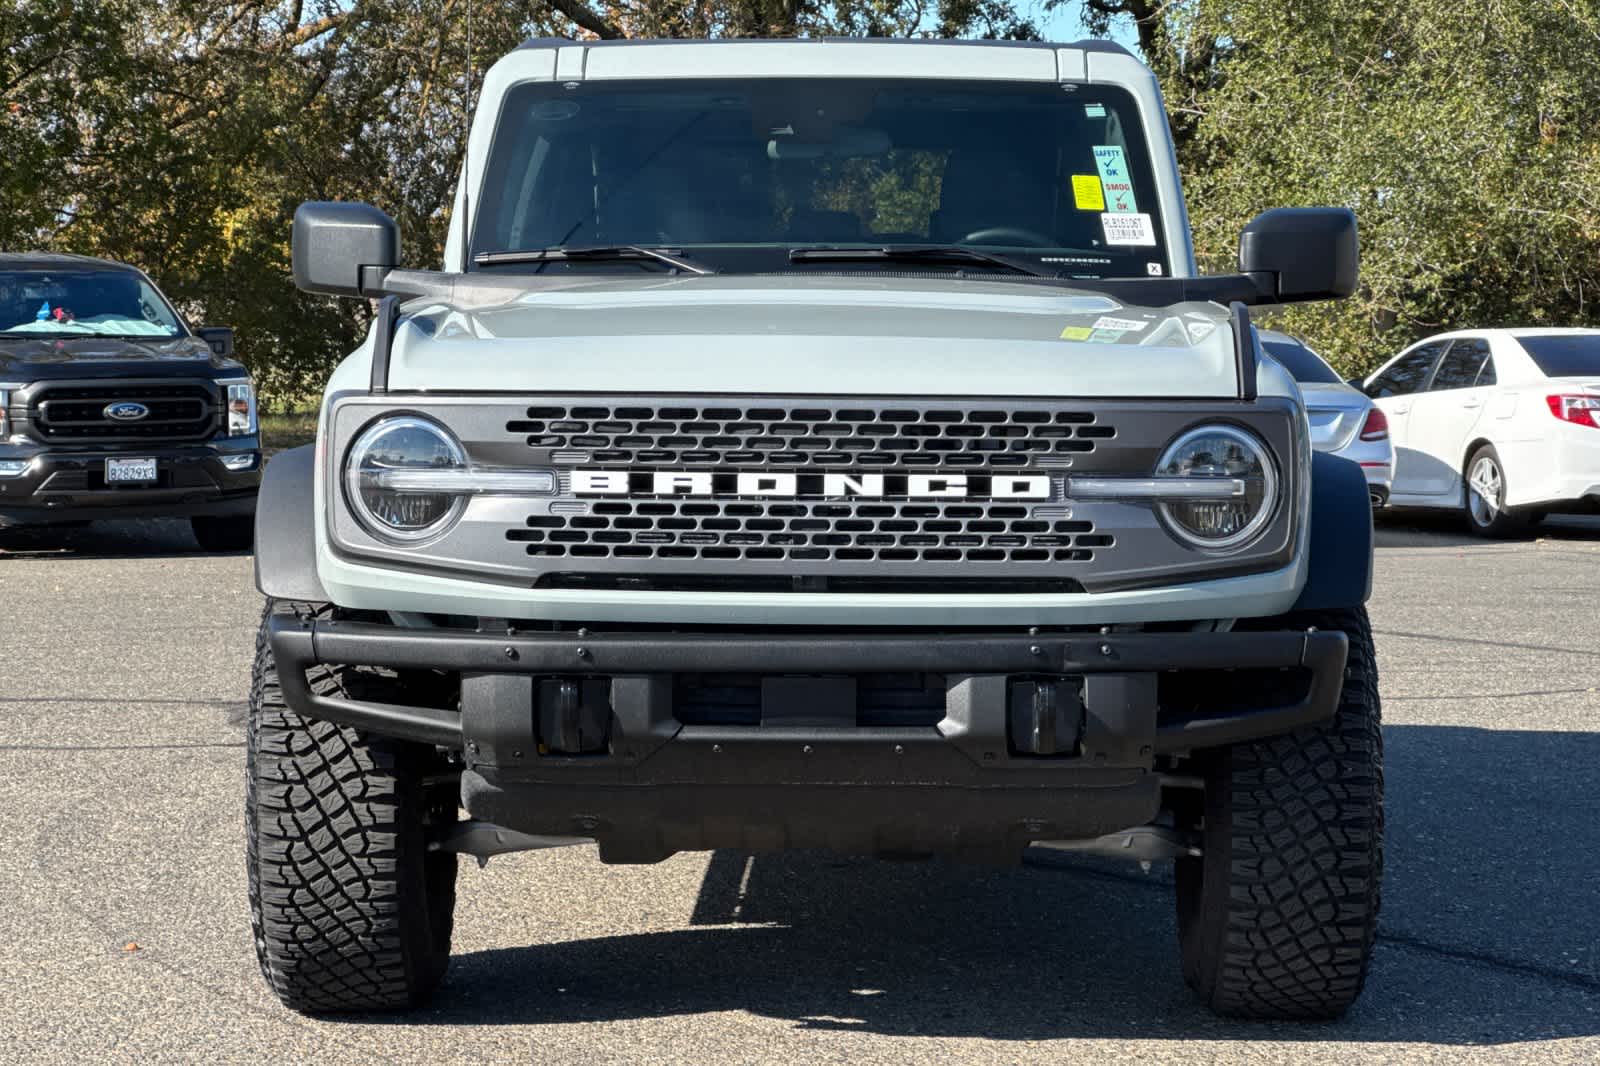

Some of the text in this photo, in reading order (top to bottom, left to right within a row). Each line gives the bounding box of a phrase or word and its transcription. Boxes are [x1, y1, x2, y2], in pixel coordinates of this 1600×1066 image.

[1095, 149, 1120, 157] SAFETY
[1106, 168, 1119, 176] OK
[117, 406, 139, 416] Ford
[569, 470, 1051, 499] BRONCO
